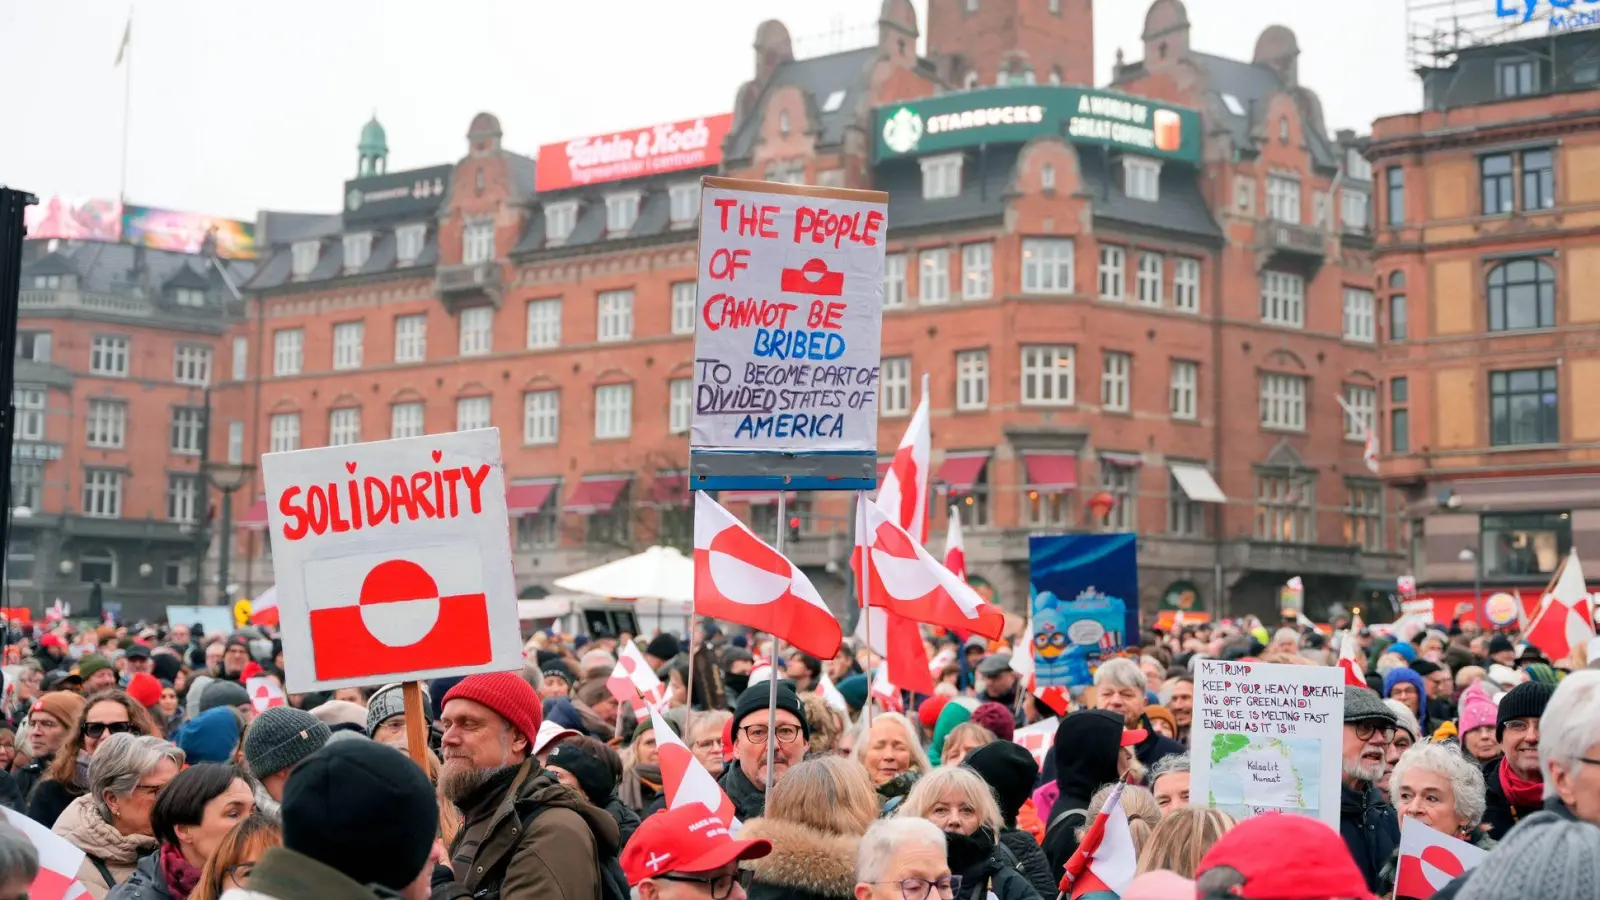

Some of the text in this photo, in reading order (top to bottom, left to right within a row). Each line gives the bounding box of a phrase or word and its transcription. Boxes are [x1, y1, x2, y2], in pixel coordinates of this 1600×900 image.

[1078, 94, 1091, 114] A
[927, 105, 1043, 133] STARBUCKS
[1069, 116, 1112, 140] GREAT
[714, 199, 885, 249] THE PEOPLE
[709, 248, 751, 281] OF
[703, 293, 847, 331] CANNOT BE
[753, 328, 846, 360] BRIBED
[696, 358, 880, 387] TO BECOME PART OF
[779, 389, 846, 411] STATES
[849, 391, 875, 410] OF
[734, 413, 844, 438] AMERICA
[1202, 662, 1251, 676] Mr. TRUMP
[1202, 680, 1231, 691] KEEP
[1235, 682, 1261, 694] YOUR
[1265, 683, 1298, 696] HEAVY
[1223, 696, 1242, 706] OFF
[1247, 697, 1311, 708] GREENLAND!
[1202, 708, 1223, 718] THE
[1262, 711, 1300, 721] MELTING
[1304, 713, 1329, 723] FAST
[1203, 720, 1241, 731] ENOUGH
[1244, 722, 1258, 732] AS
